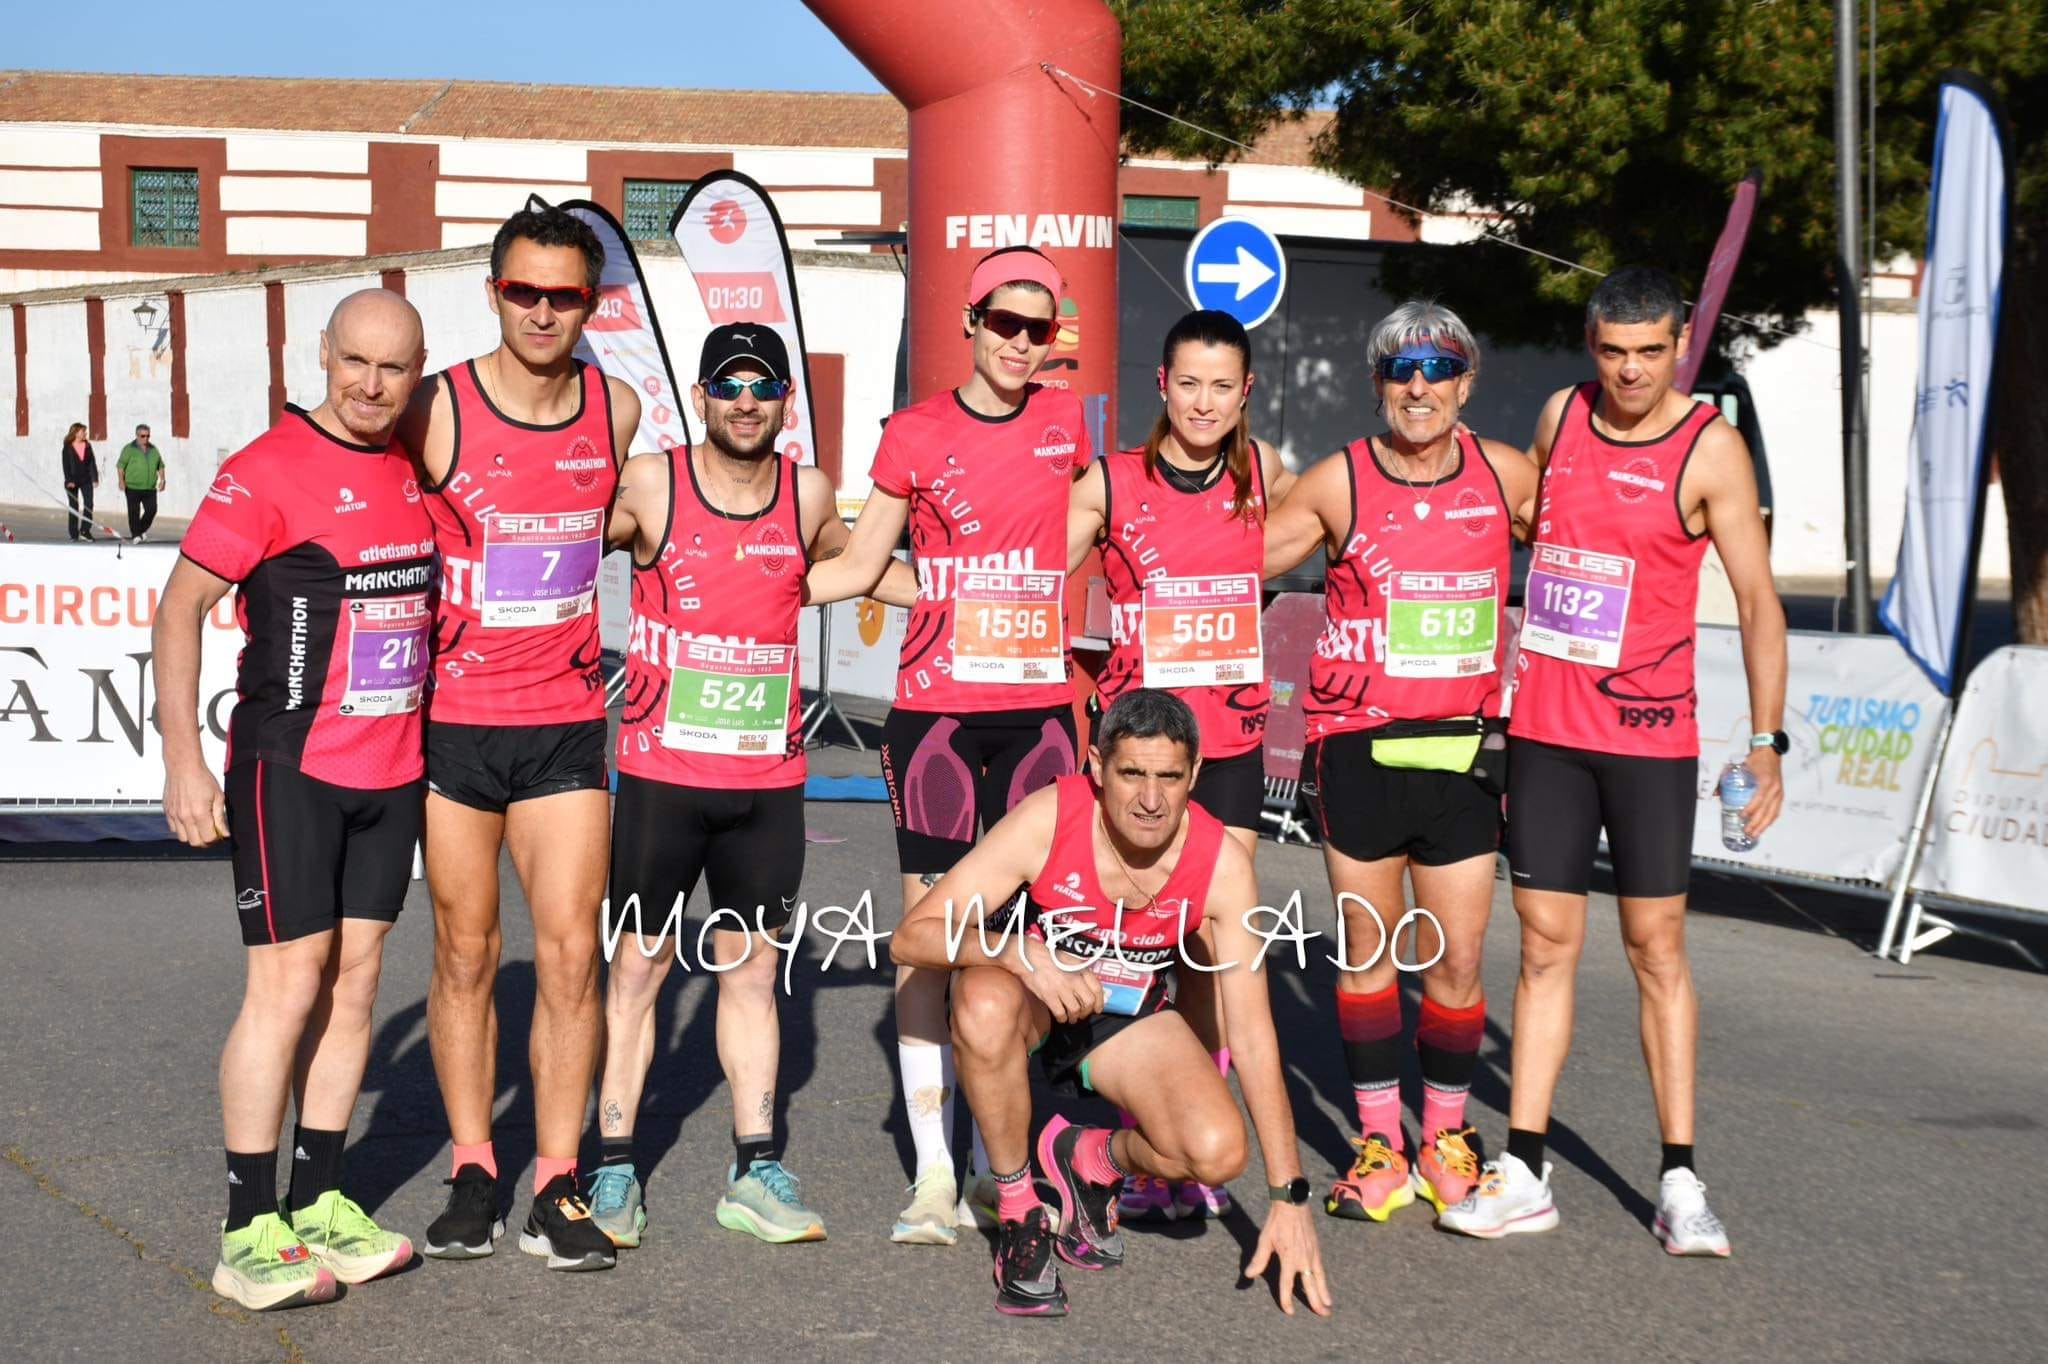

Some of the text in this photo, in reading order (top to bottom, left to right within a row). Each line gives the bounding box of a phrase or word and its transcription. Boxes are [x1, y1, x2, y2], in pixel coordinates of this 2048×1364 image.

[946, 214, 1113, 248] FENAVIN
[708, 286, 763, 310] 01:30
[555, 457, 608, 472] MANCHATHON
[334, 500, 368, 514] VIATOR
[931, 478, 982, 536] CLUB
[498, 512, 598, 535] SOLISS
[358, 542, 418, 563] atletismo
[745, 543, 798, 557] MANCHATHON
[1540, 549, 1625, 577] SOLISS
[344, 565, 430, 592] MANCHATH
[541, 550, 561, 582] 7
[660, 541, 701, 610] CLUB
[1154, 578, 1249, 598] SOLISS
[1400, 573, 1492, 592] SOLISS
[0, 583, 239, 631] CIRCUO
[1543, 580, 1605, 621] 1132
[976, 607, 1048, 640] 1596
[1172, 611, 1236, 644] 560
[1420, 607, 1477, 638] 613
[285, 596, 308, 711] MANCHATHON
[687, 643, 786, 666] SOLISS
[699, 678, 767, 713] 524
[1617, 705, 1675, 728] 1999
[1803, 694, 1922, 732] TURISMO
[1819, 726, 1915, 762] CIUDAD
[1835, 755, 1901, 792] REAL
[1944, 810, 2048, 848] CIUDA
[1052, 883, 1086, 903] VIATOR
[1132, 932, 1165, 946] club
